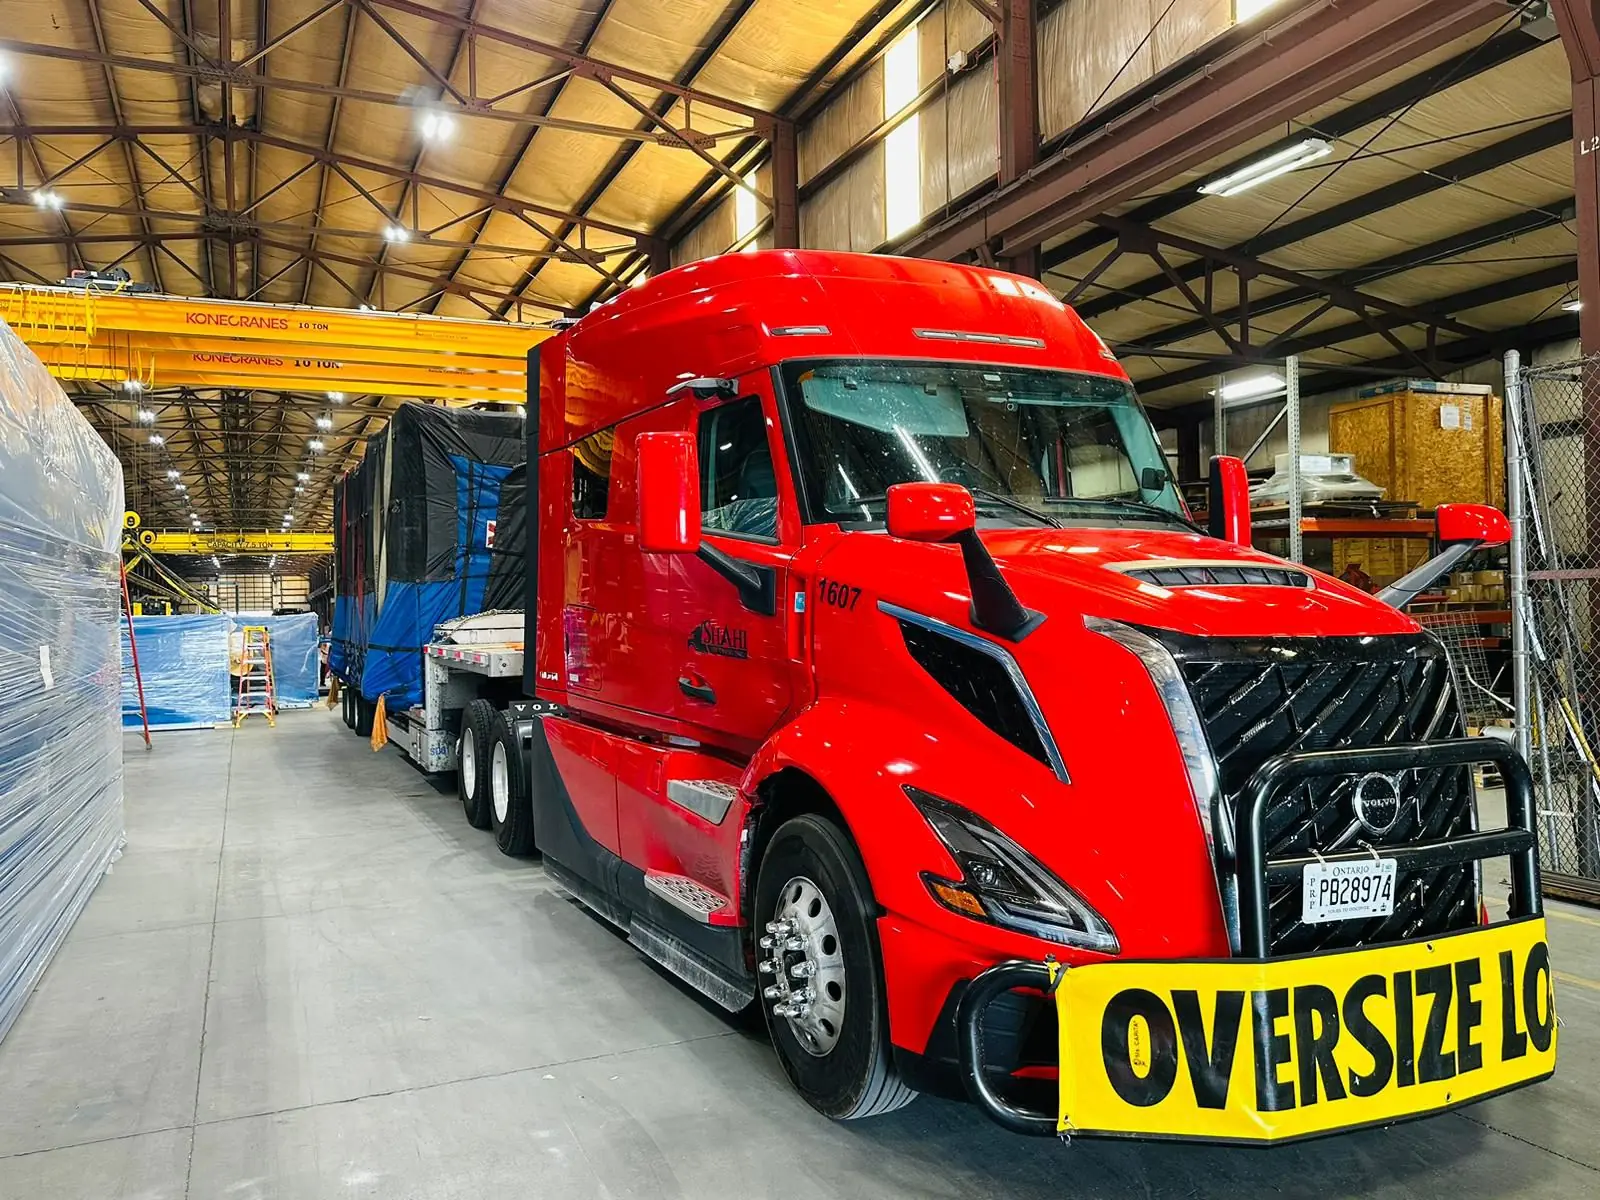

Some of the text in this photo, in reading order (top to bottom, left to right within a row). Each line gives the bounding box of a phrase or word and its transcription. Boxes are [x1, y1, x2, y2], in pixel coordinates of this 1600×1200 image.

[185, 312, 289, 330] KONECRANES
[312, 323, 329, 331] TON
[192, 353, 340, 369] KONECRANES 10 TON
[259, 541, 273, 549] TON
[819, 577, 862, 612] 1607
[702, 619, 747, 649] SHAHI
[514, 703, 558, 712] VOL
[1362, 797, 1396, 807] VOLVO
[1332, 865, 1370, 876] ONTARIO
[1319, 874, 1392, 907] PB28974
[1101, 940, 1553, 1112] OVERSIZE LO
